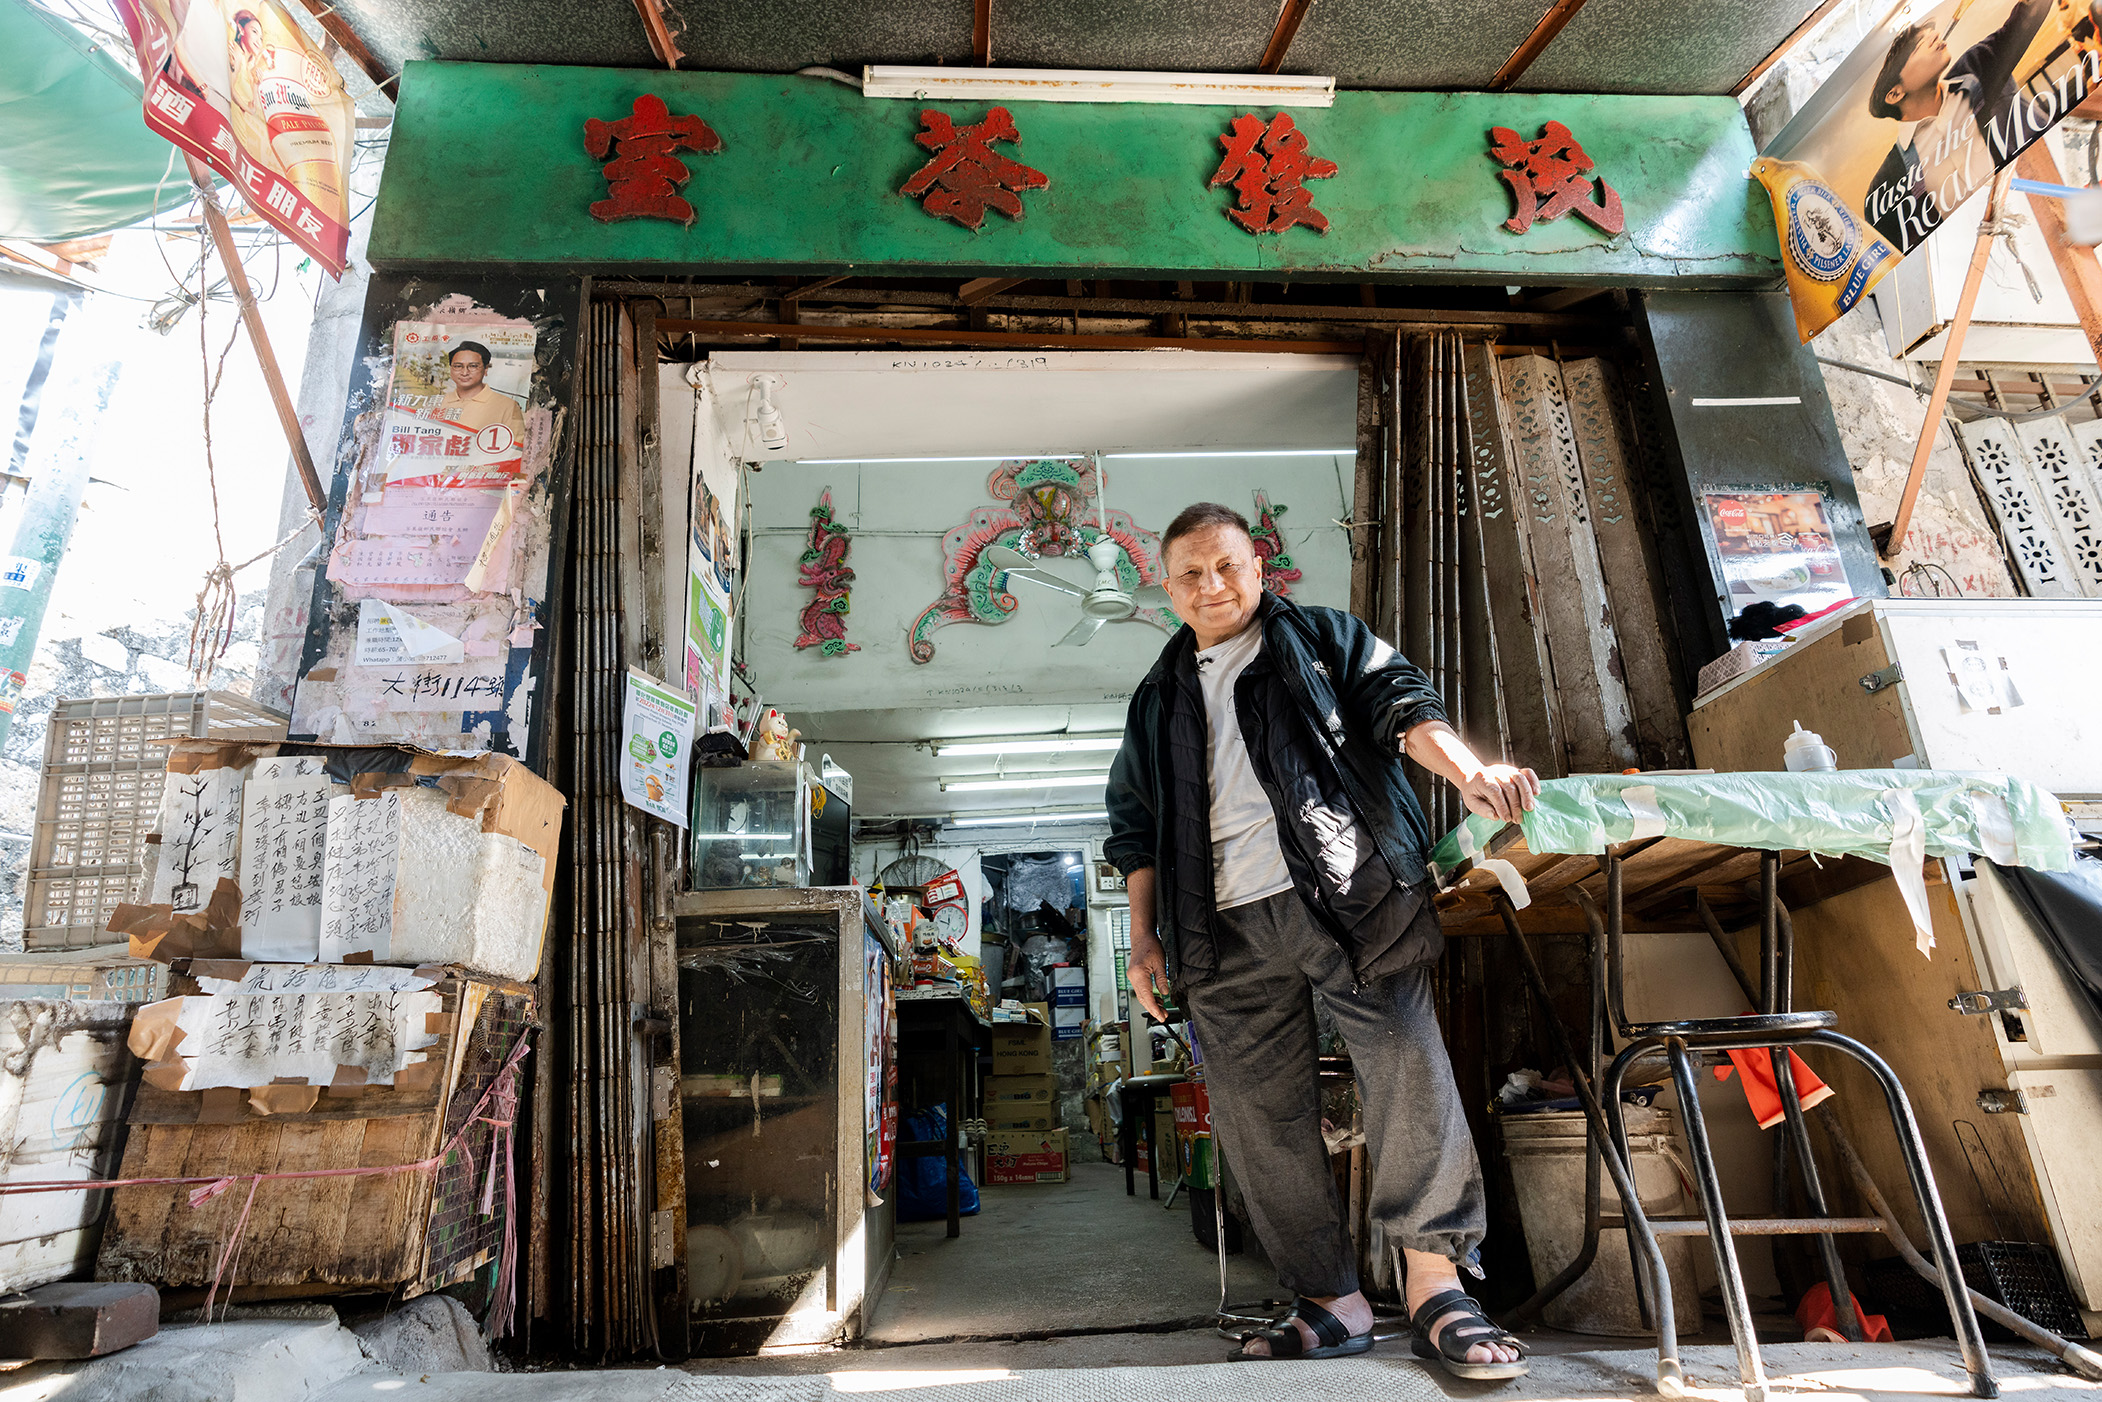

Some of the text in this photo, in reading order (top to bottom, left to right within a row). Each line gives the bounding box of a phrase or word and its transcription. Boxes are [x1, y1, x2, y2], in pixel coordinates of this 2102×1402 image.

[281, 120, 300, 129] PALE
[151, 78, 196, 125] 酒
[211, 124, 324, 242] 真正朋友
[1865, 113, 1975, 226] Taste the
[1900, 137, 1979, 257] Real
[1814, 255, 1844, 269] PILSENER
[1844, 226, 1855, 257] LAGER
[1842, 244, 1887, 307] BLUE GIRL
[392, 425, 441, 436] Bill Tang
[486, 427, 500, 451] 1
[423, 509, 454, 522] 通告
[1719, 508, 1745, 518] Coca-Cola
